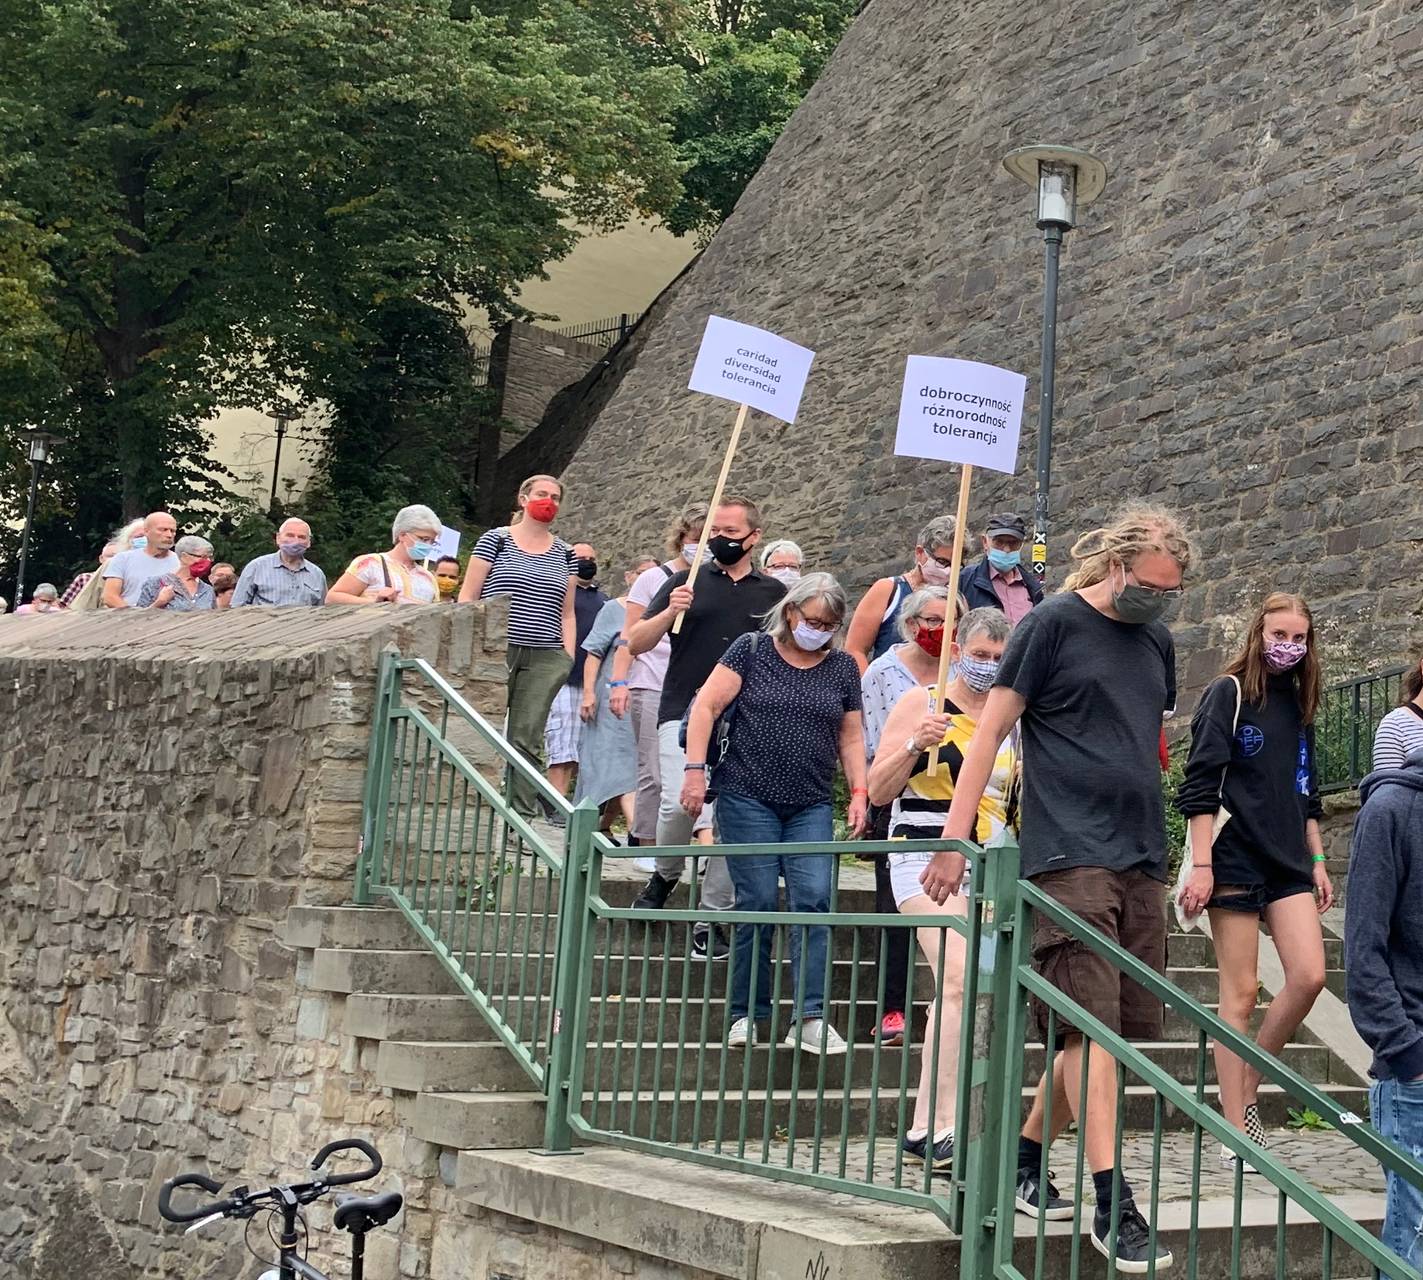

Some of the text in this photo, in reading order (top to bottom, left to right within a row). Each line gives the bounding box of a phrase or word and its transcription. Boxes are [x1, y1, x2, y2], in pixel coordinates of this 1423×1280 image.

[724, 356, 781, 383] diversidad
[736, 346, 778, 368] caridad
[721, 368, 777, 395] tolerancia
[920, 385, 1012, 414] dobroczynność
[922, 402, 1007, 430] różnorodność
[933, 421, 998, 446] tolerancja
